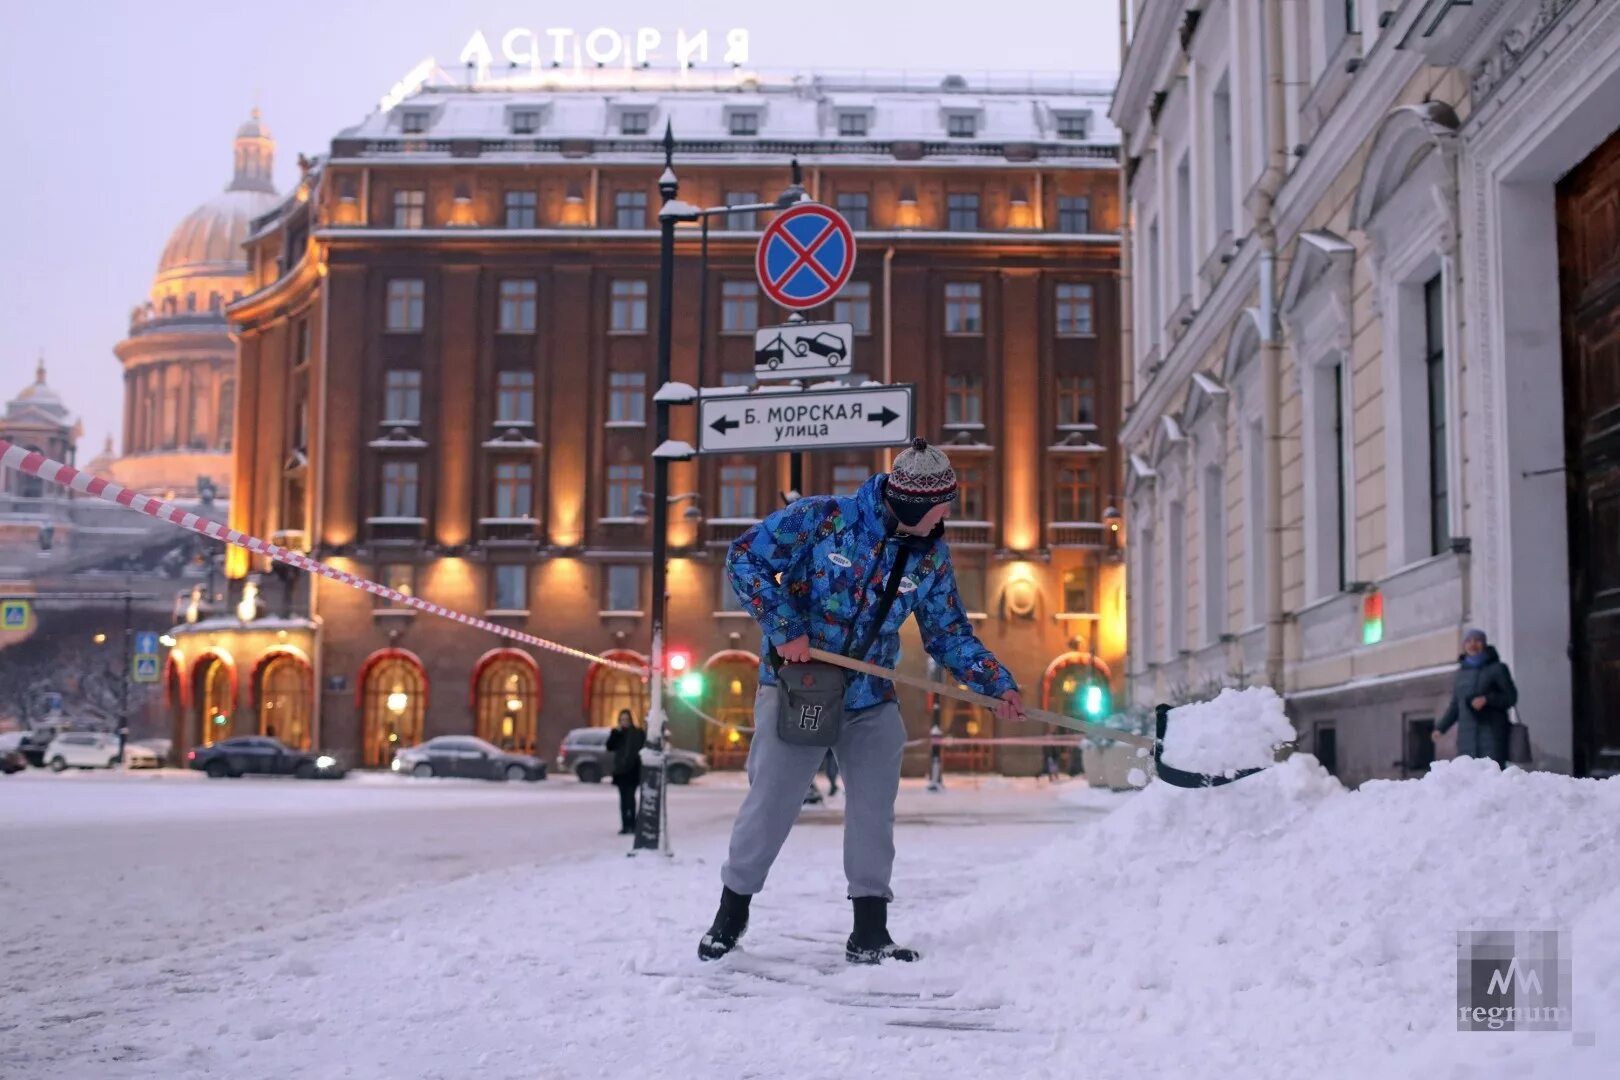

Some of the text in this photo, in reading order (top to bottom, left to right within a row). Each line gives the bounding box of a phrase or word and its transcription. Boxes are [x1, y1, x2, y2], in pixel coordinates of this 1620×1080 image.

[460, 28, 750, 63] АСТОРИЯ
[744, 402, 863, 424] Б. МОРСКАЯ
[775, 423, 829, 441] улица
[799, 705, 823, 731] H
